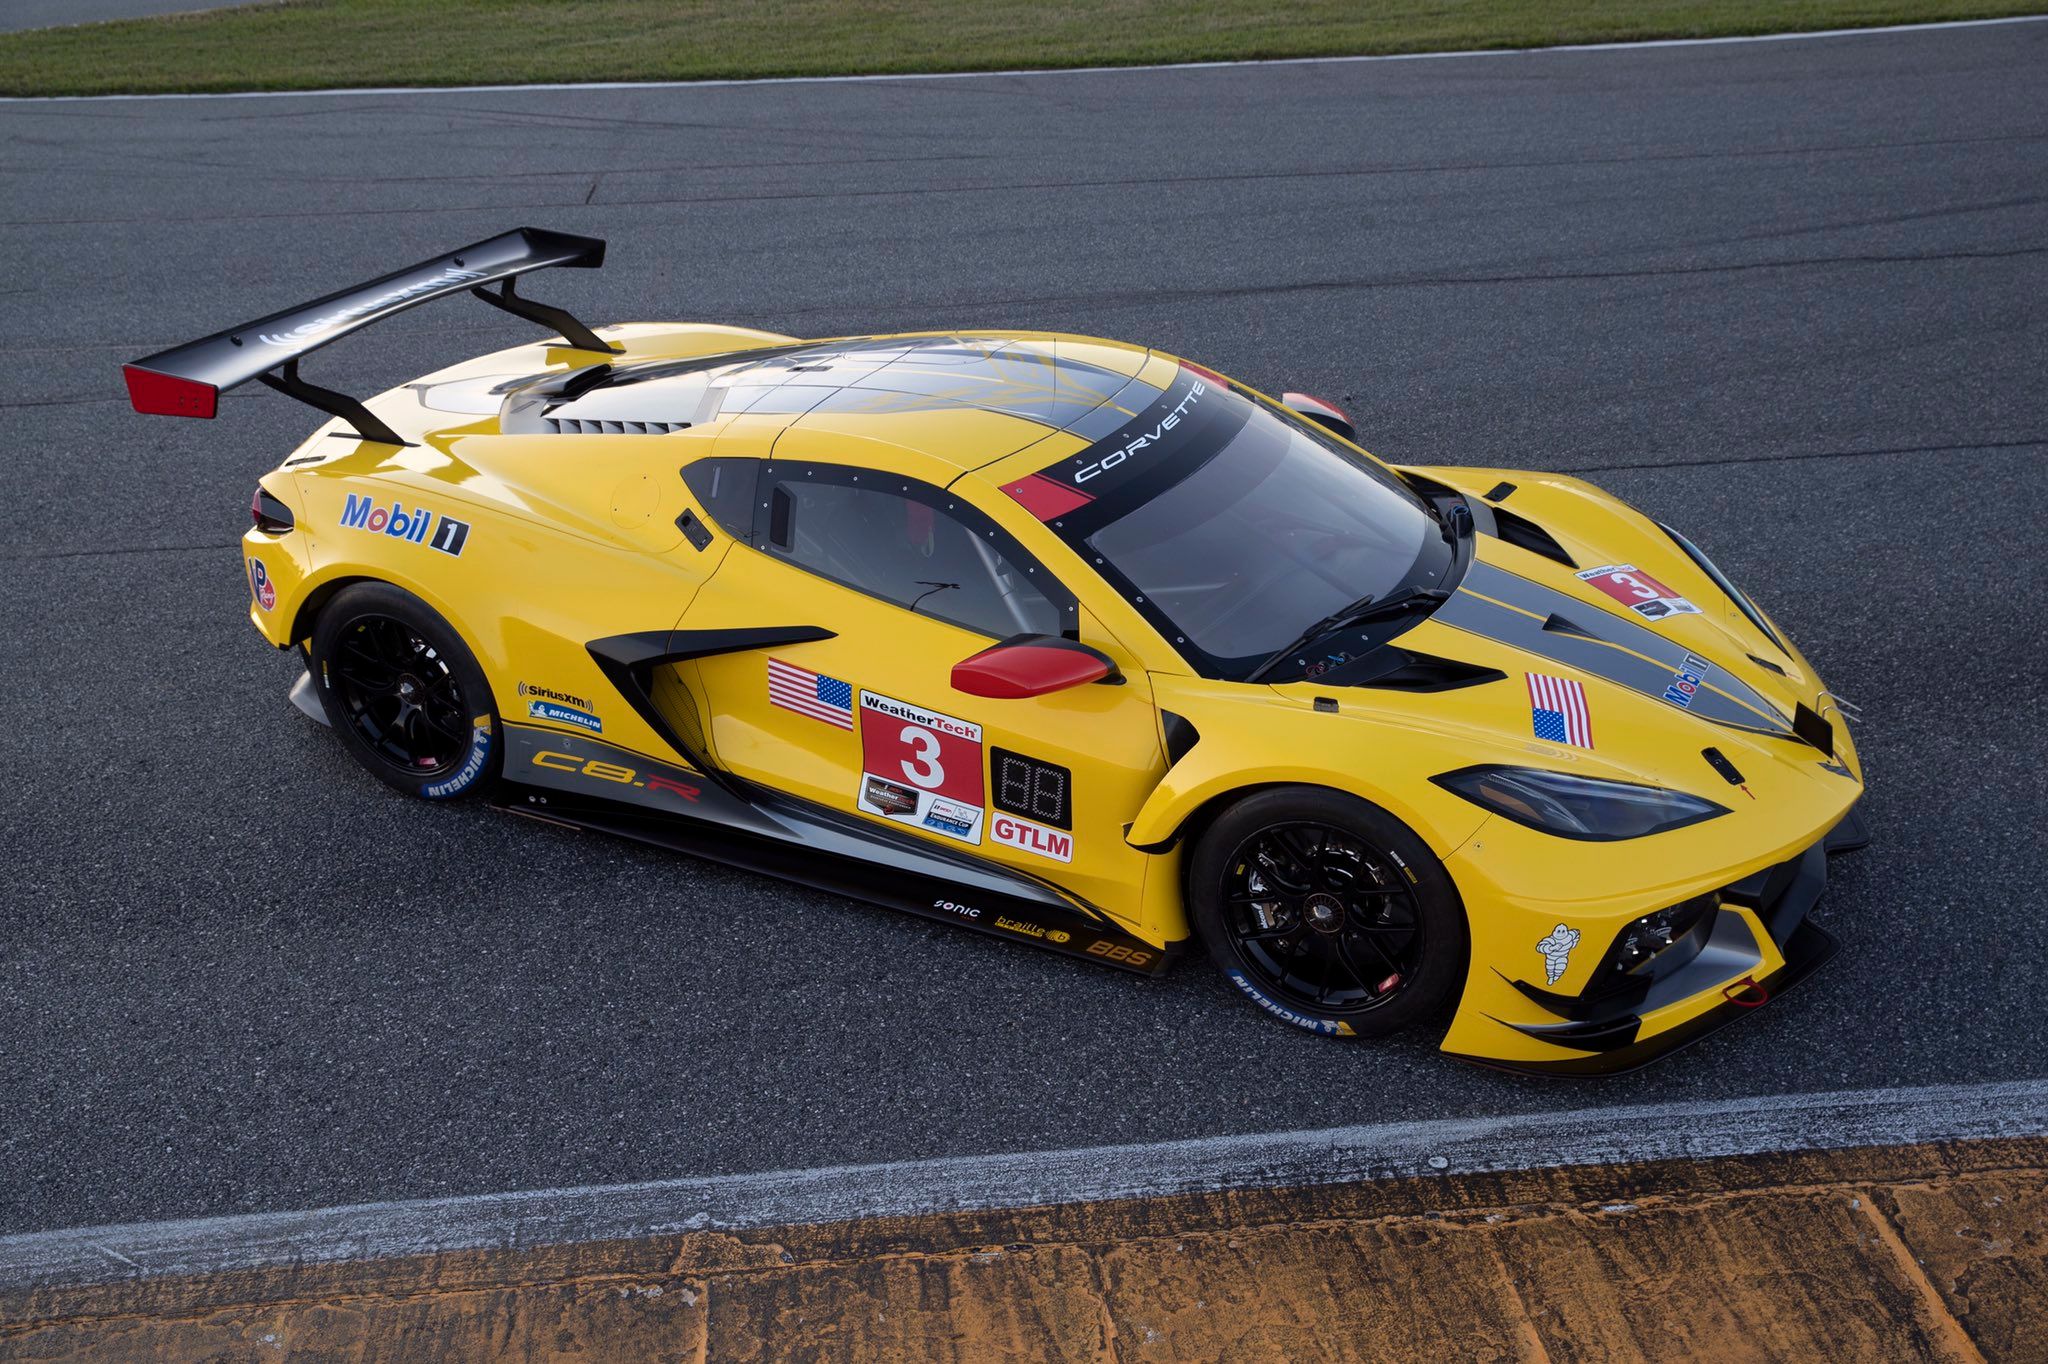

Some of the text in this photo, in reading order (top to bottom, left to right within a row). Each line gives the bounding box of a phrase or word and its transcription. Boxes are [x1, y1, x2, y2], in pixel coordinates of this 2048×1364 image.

[1074, 380, 1207, 484] CORVETTE
[340, 493, 432, 544] Mobil
[1610, 572, 1660, 599] 3
[1663, 663, 1705, 708] Mobil
[548, 709, 601, 728] MICHELIN
[864, 694, 977, 739] WeatherTech
[427, 746, 486, 797] MICHELIN
[532, 750, 701, 803] C8.R
[900, 725, 945, 789] 3
[994, 819, 1070, 858] GTLM
[996, 915, 1046, 935] braille
[1086, 940, 1152, 965] BBS
[1232, 975, 1319, 1030] MICHELIN
